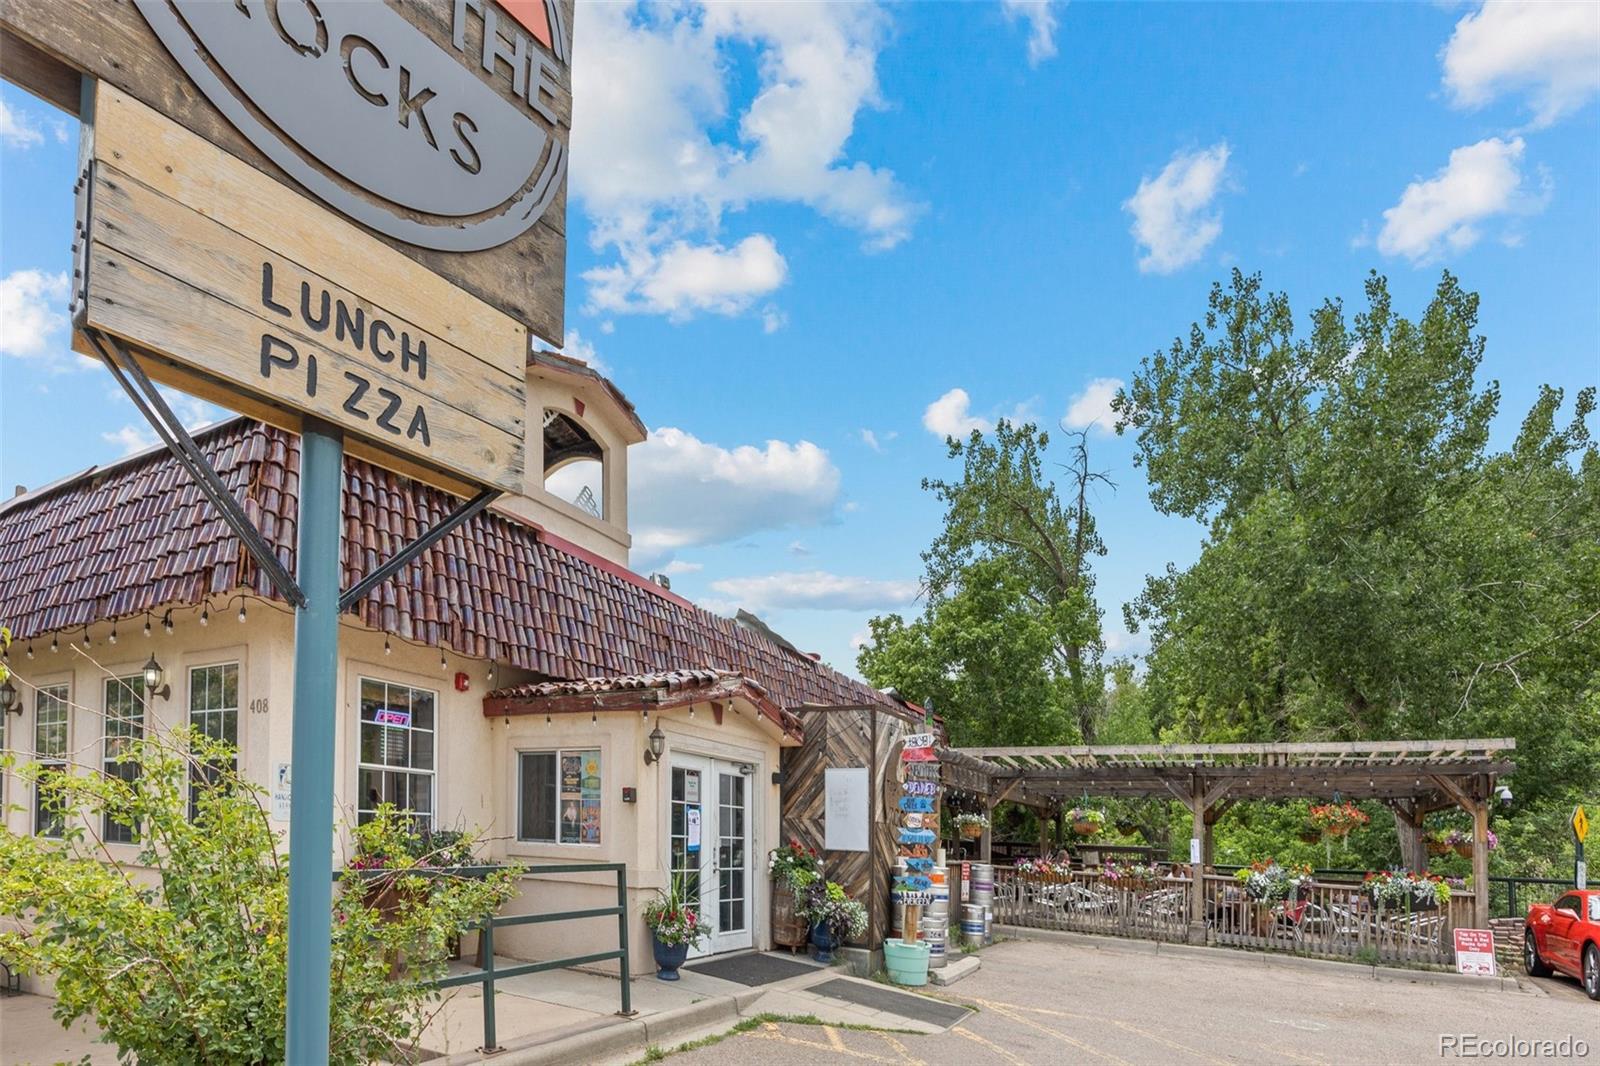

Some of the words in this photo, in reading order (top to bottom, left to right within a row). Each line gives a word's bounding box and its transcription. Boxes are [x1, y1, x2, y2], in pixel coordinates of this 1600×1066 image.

[234, 0, 482, 175] OCKS
[451, 0, 561, 126] THE
[262, 262, 427, 381] LUNCH
[260, 333, 431, 447] PIZZA
[249, 698, 269, 714] 408
[379, 712, 407, 725] OPEN
